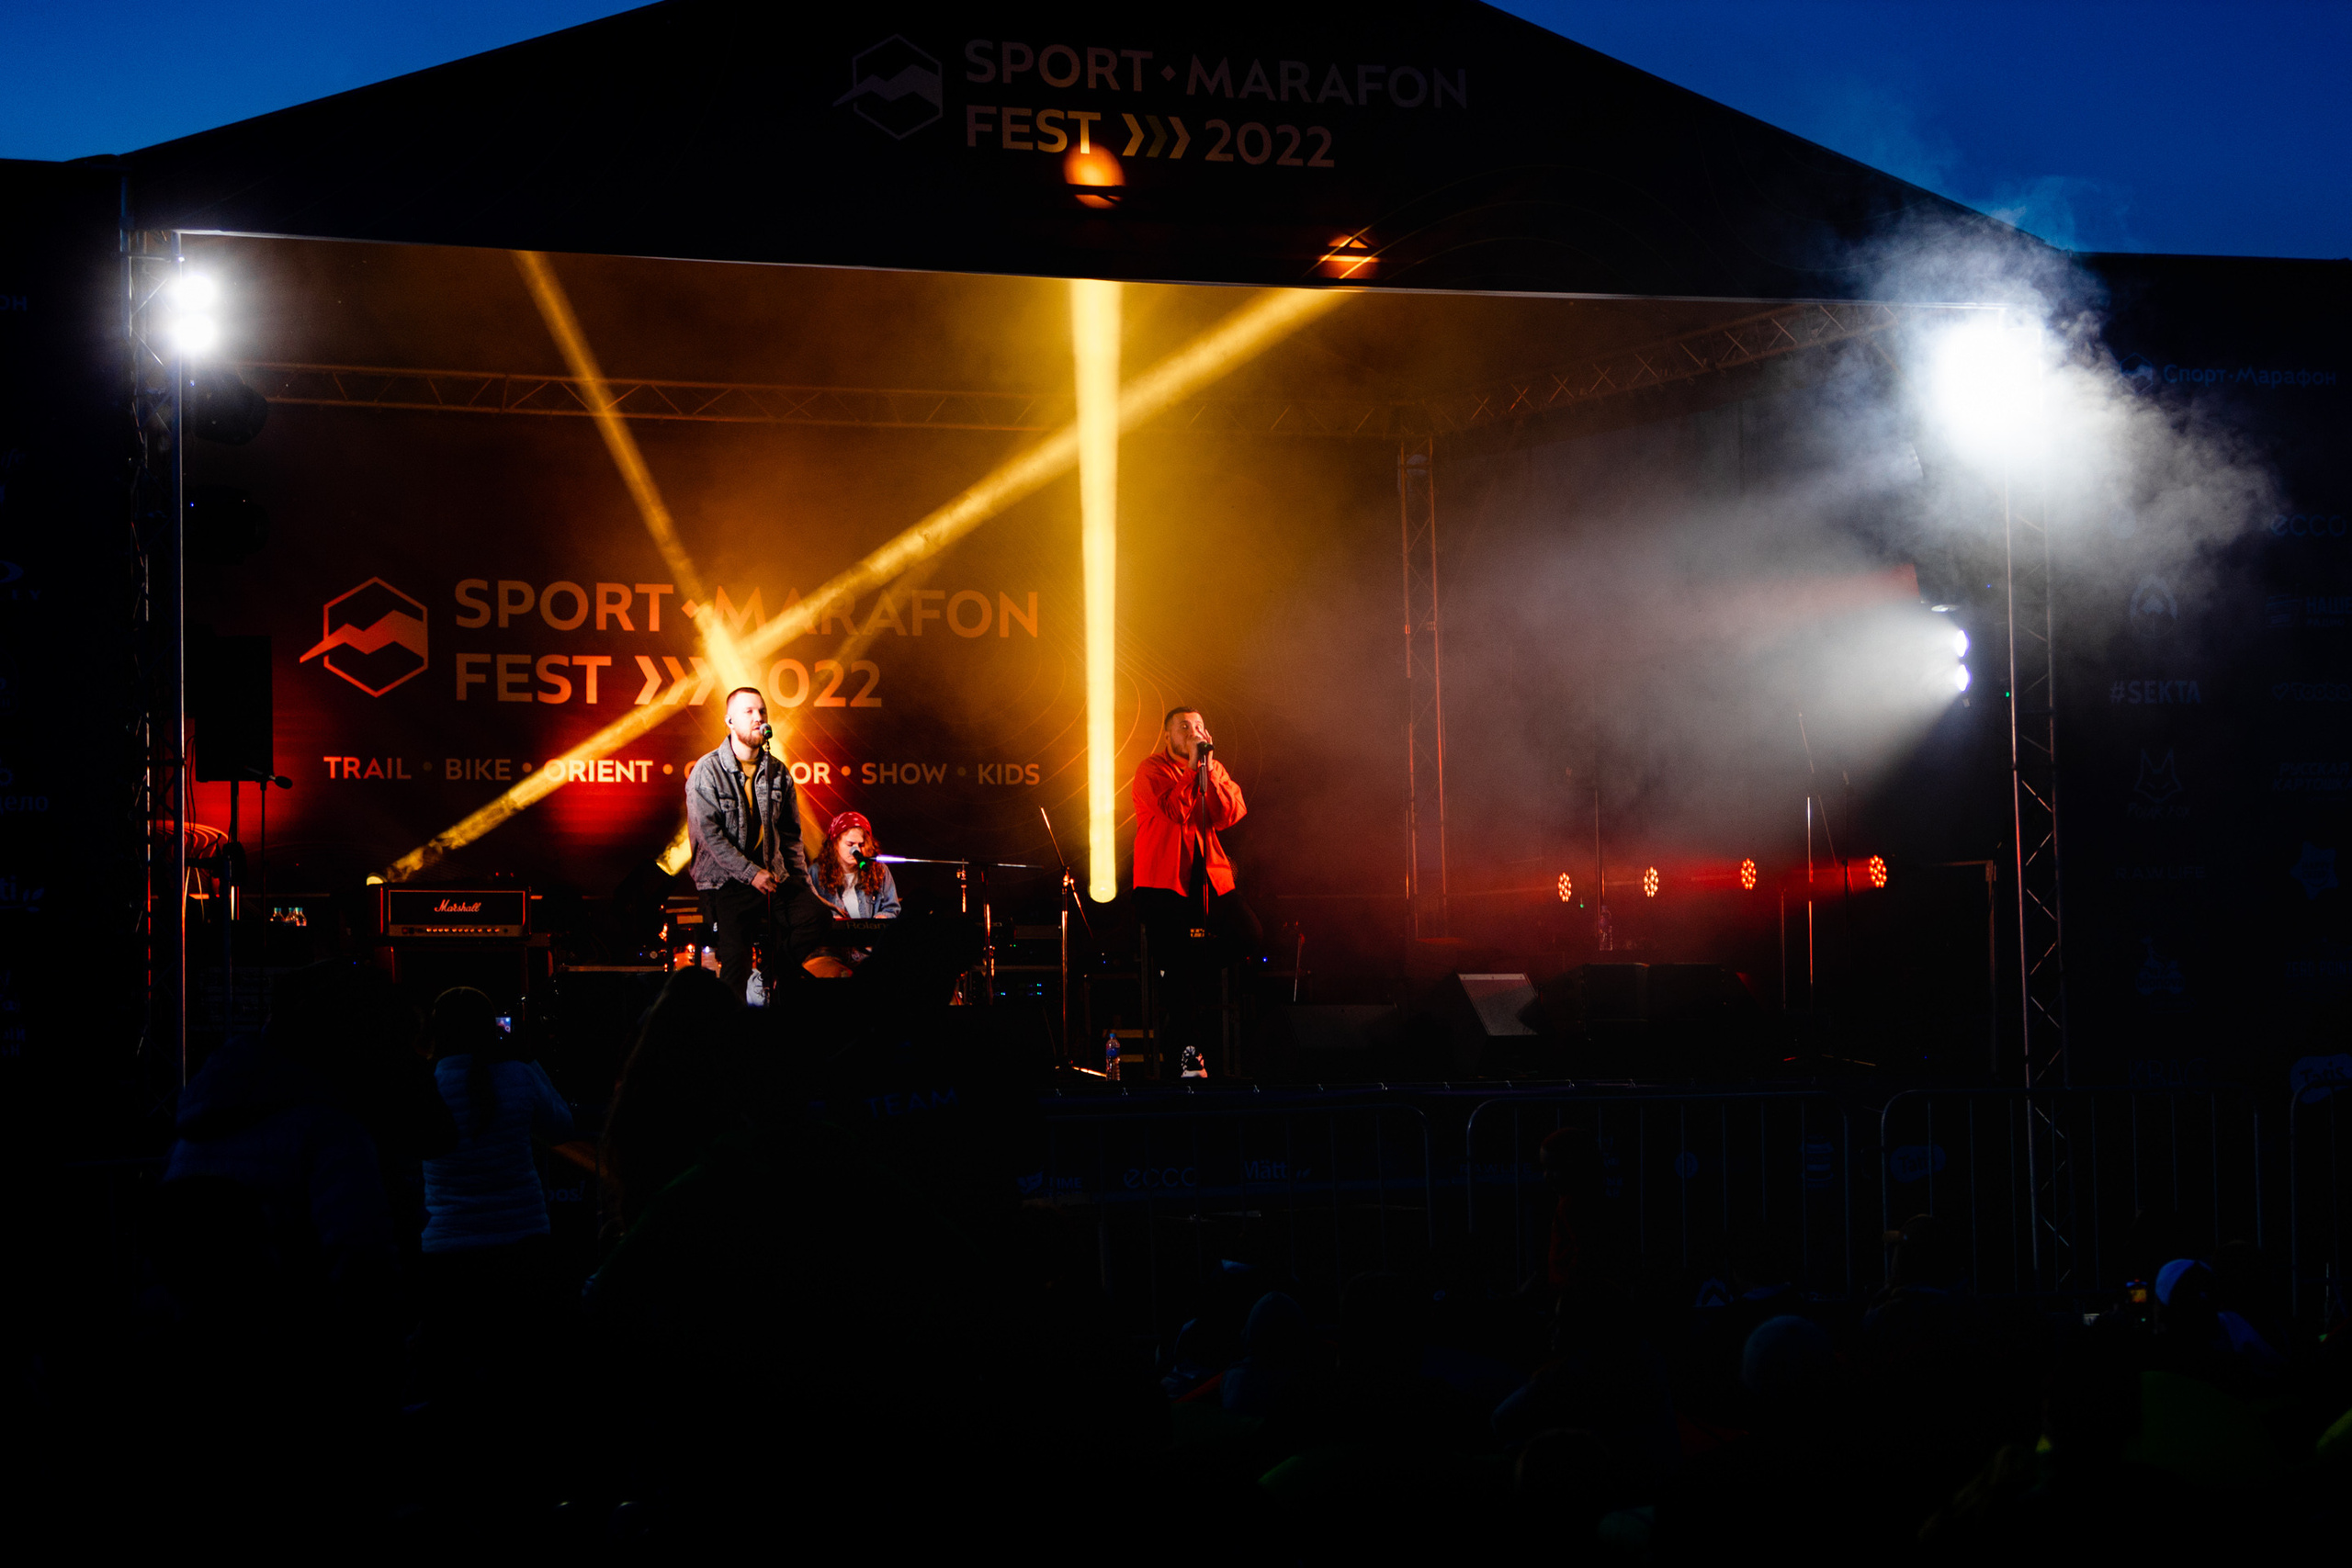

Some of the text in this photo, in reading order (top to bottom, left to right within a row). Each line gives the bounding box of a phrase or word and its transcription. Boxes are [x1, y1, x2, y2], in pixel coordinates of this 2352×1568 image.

[964, 38, 1468, 110] SPORT MARAFON
[966, 104, 1336, 169] FEST 2022
[455, 578, 1039, 639] SPORT MARAFON
[456, 653, 612, 705] FEST
[2109, 680, 2202, 705] #SEKTA
[323, 756, 413, 780] TRAIL
[445, 758, 512, 781] BIKE
[543, 759, 654, 784] ORIENT
[861, 762, 948, 785] SHOW
[977, 762, 1041, 786] KIDS
[434, 898, 481, 914] Marshall
[845, 919, 888, 931] Rolan
[863, 1085, 960, 1121] TEAM
